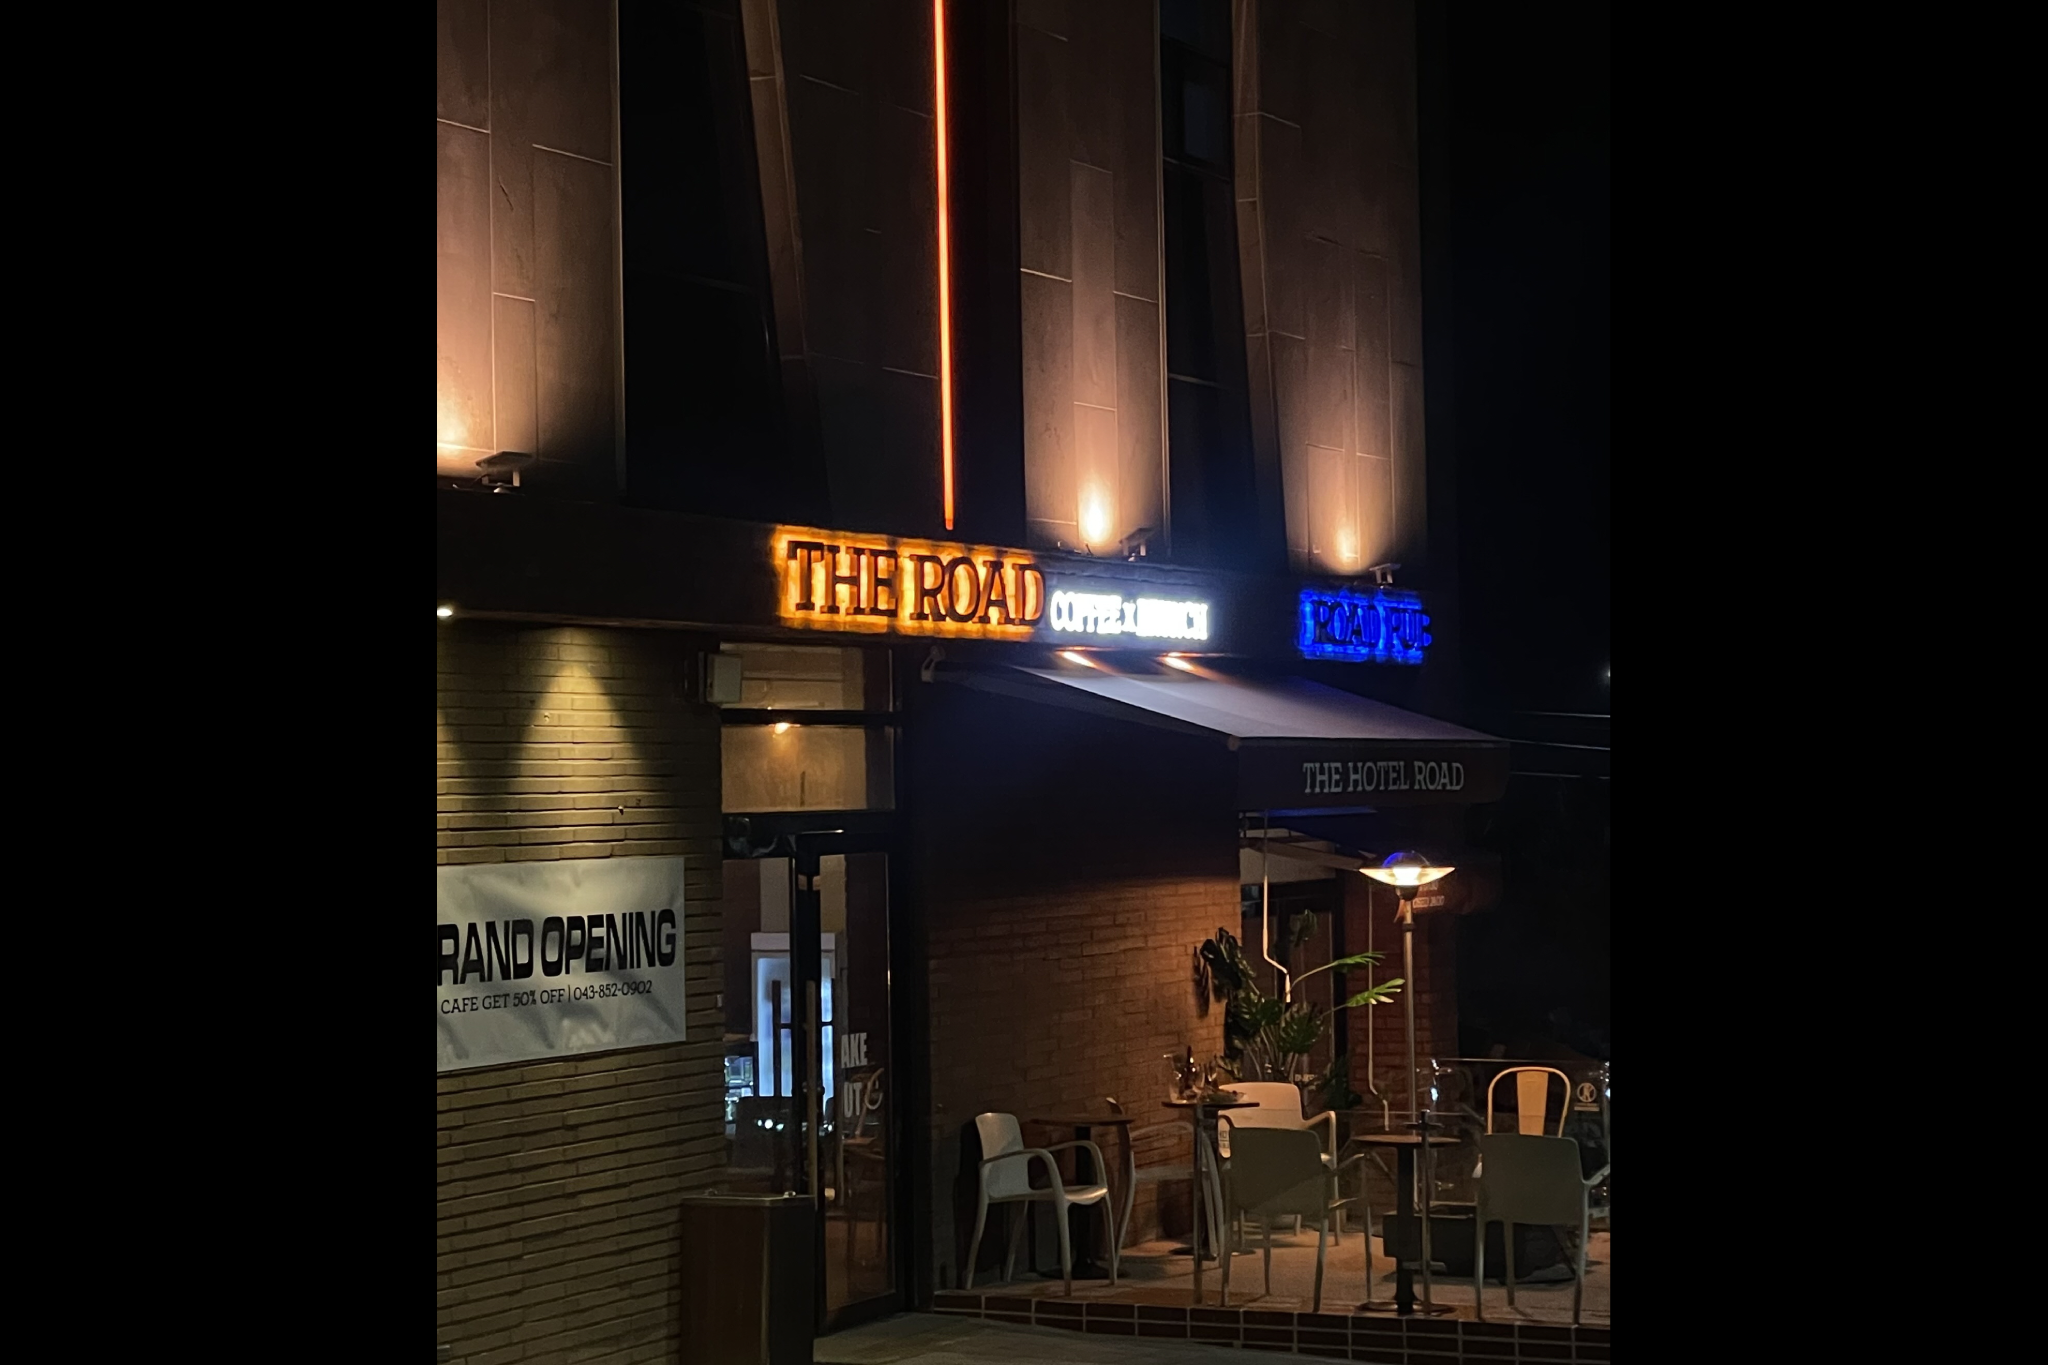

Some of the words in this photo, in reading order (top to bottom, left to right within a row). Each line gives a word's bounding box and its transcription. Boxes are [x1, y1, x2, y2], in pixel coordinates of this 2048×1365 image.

[787, 540, 898, 618] THE
[909, 553, 1046, 626] ROAD
[1051, 590, 1122, 634] COFFEE
[1302, 762, 1343, 794] THE
[1346, 761, 1410, 793] HOTEL
[1413, 761, 1465, 791] ROAD
[540, 908, 677, 978] OPENING
[440, 996, 479, 1015] CAFE
[482, 993, 510, 1011] GET
[512, 990, 537, 1009] 50%
[539, 988, 565, 1006] OFF
[573, 979, 653, 1002] 043-852-0902
